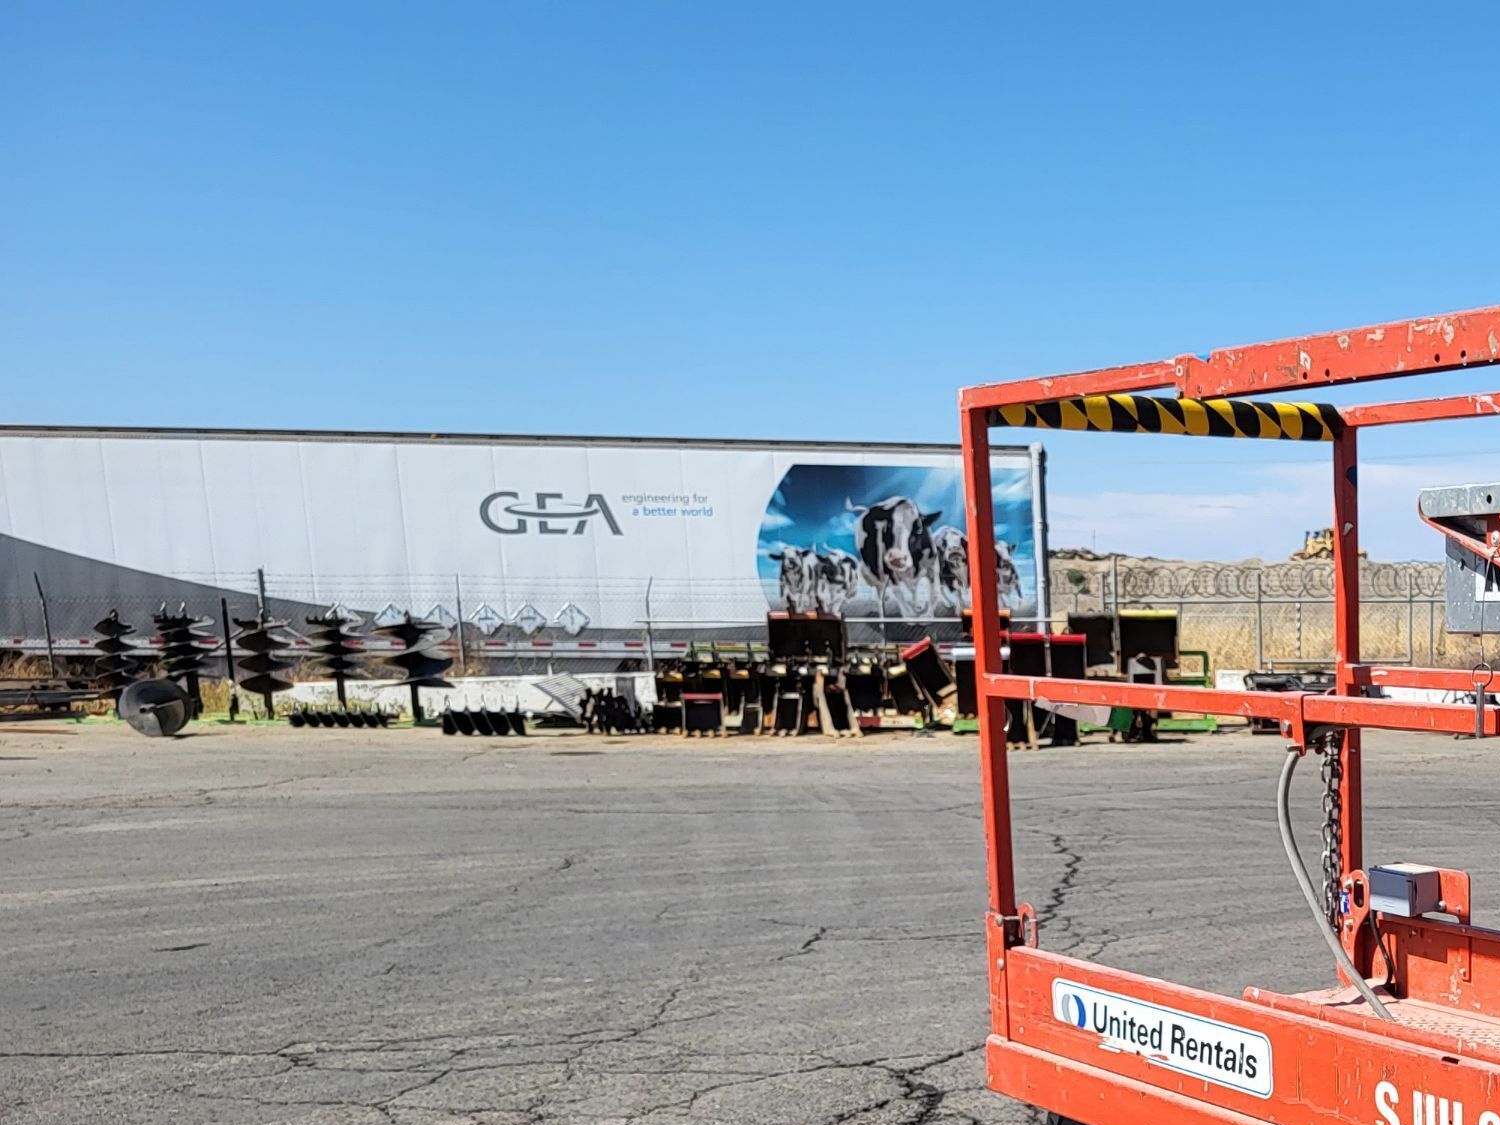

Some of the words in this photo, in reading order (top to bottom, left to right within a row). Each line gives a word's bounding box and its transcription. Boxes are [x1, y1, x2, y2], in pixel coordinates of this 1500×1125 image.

[480, 491, 624, 535] GEA
[622, 493, 690, 505] engineering
[692, 493, 709, 504] for
[632, 508, 639, 516] a
[643, 506, 677, 517] better
[681, 507, 714, 517] world
[1093, 1002, 1163, 1051] United
[1170, 1023, 1258, 1079] Rentals
